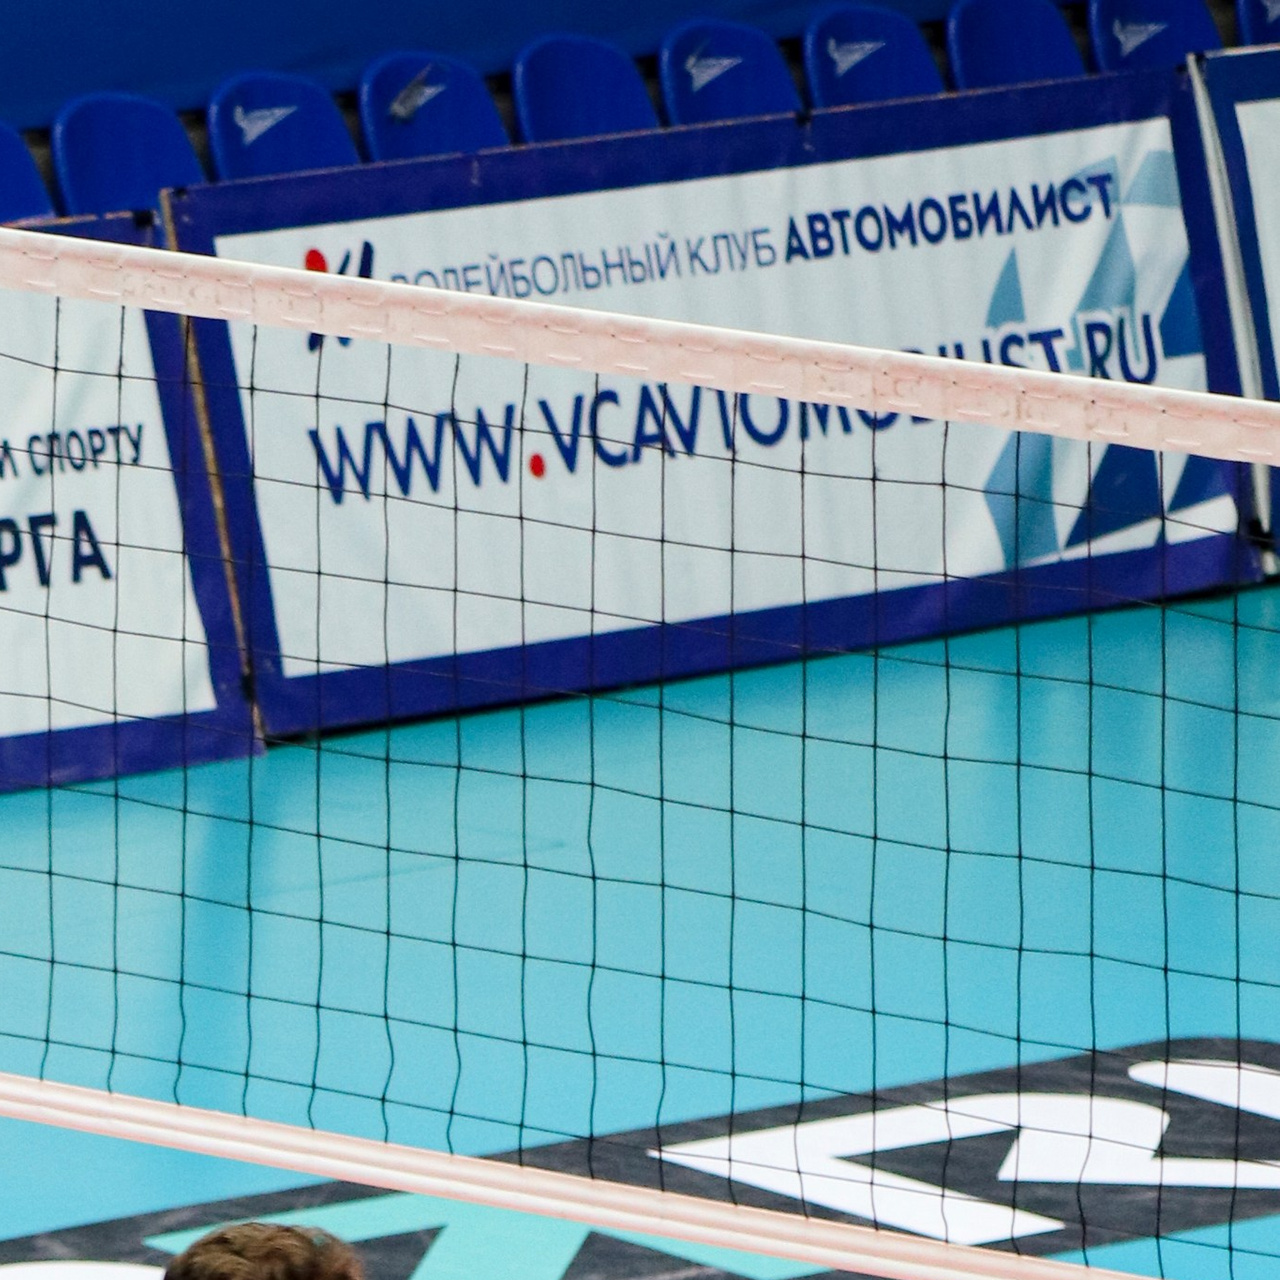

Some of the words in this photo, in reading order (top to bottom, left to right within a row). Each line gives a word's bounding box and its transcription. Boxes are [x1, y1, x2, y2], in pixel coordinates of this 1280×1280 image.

[687, 228, 777, 275] КЛУБ
[785, 173, 1115, 264] АВТОМОБИЛИСТ
[27, 423, 143, 477] СПОРТУ
